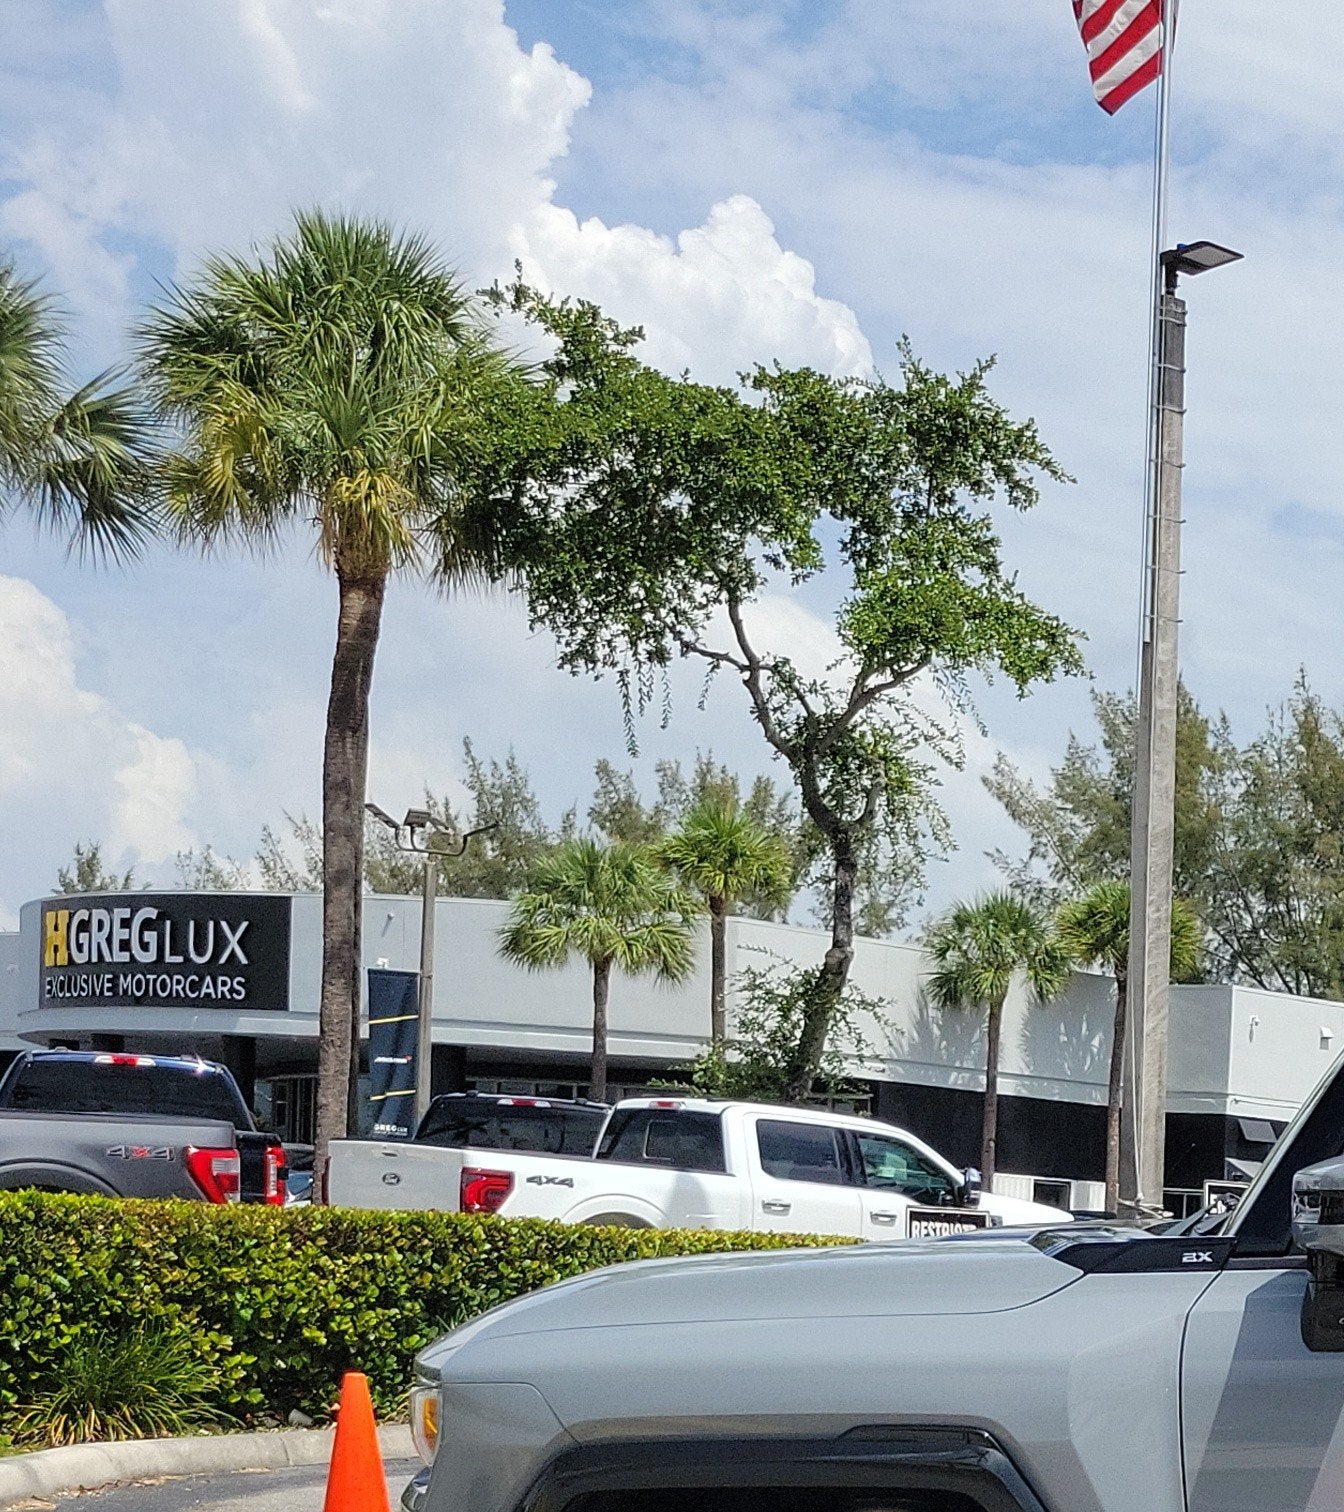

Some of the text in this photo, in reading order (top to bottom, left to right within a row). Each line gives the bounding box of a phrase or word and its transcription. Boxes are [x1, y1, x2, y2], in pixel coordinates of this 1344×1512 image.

[46, 974, 247, 1000] EXCLUSIVE MOTORCARS
[911, 1220, 977, 1239] RESTRIC
